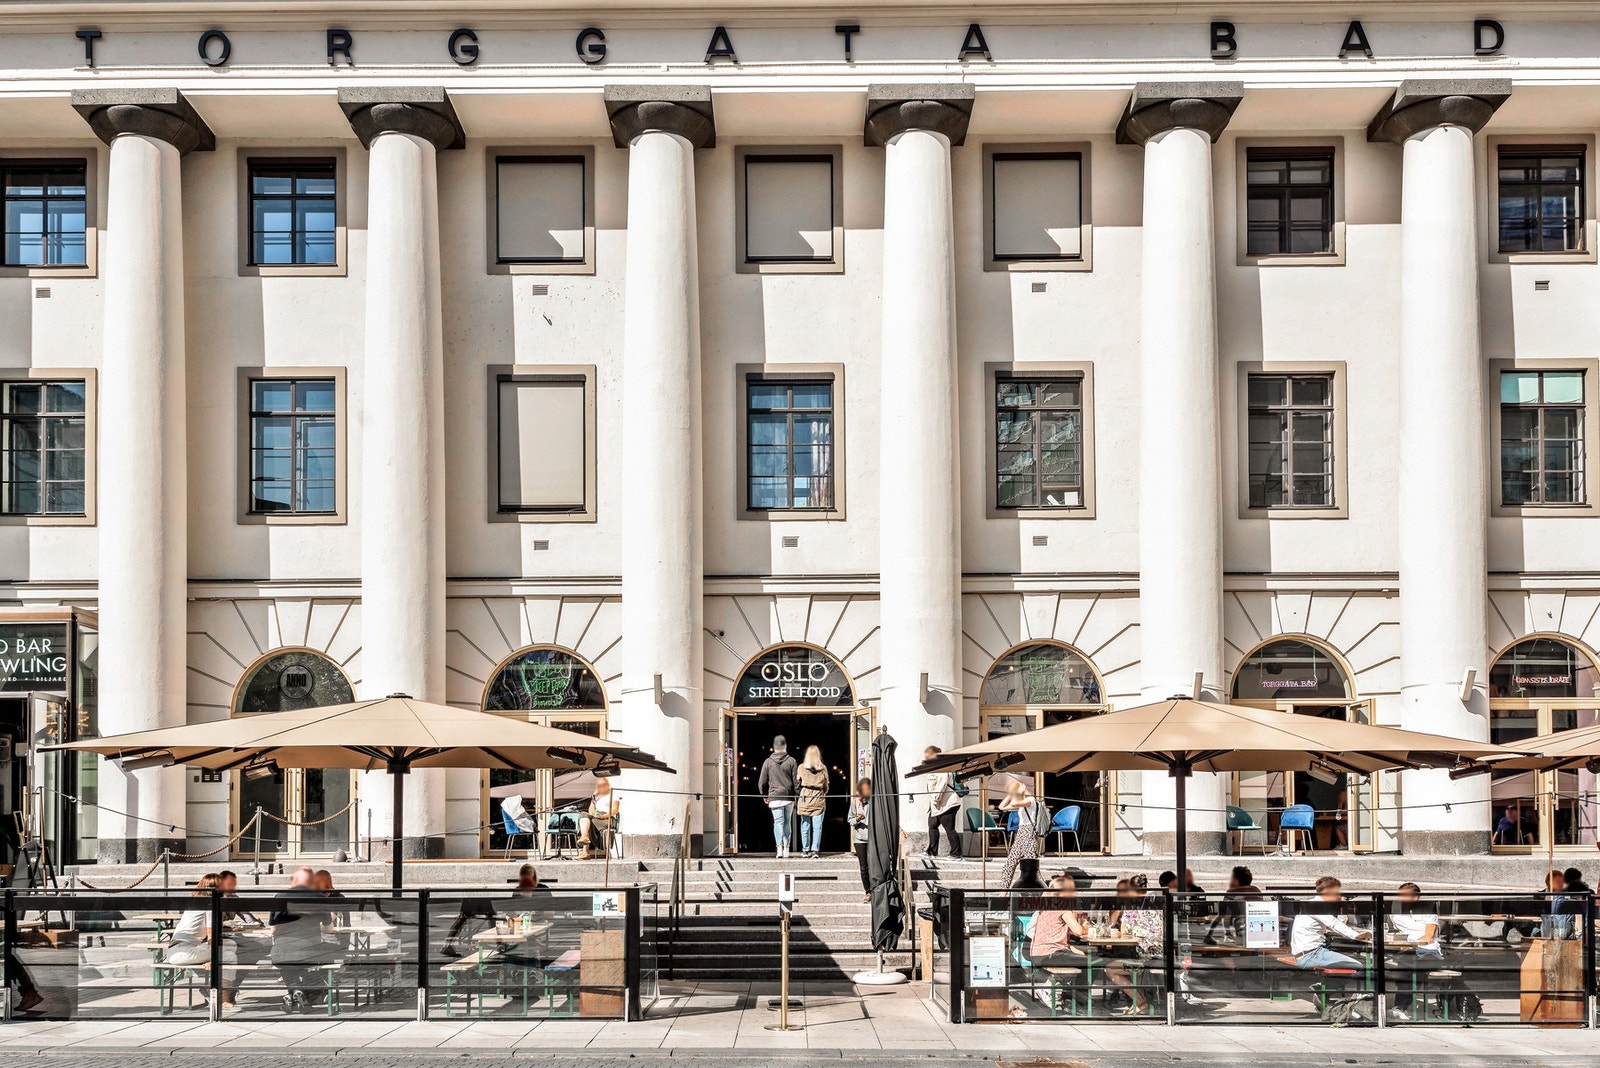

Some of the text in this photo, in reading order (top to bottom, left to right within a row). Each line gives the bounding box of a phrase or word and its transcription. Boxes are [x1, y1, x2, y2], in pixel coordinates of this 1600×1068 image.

[76, 19, 1505, 67] TORGGATA BAD
[16, 638, 52, 654] BAR
[761, 662, 829, 682] OSLO
[748, 686, 840, 698] STREET FOOD
[1262, 680, 1299, 688] TORGGATA
